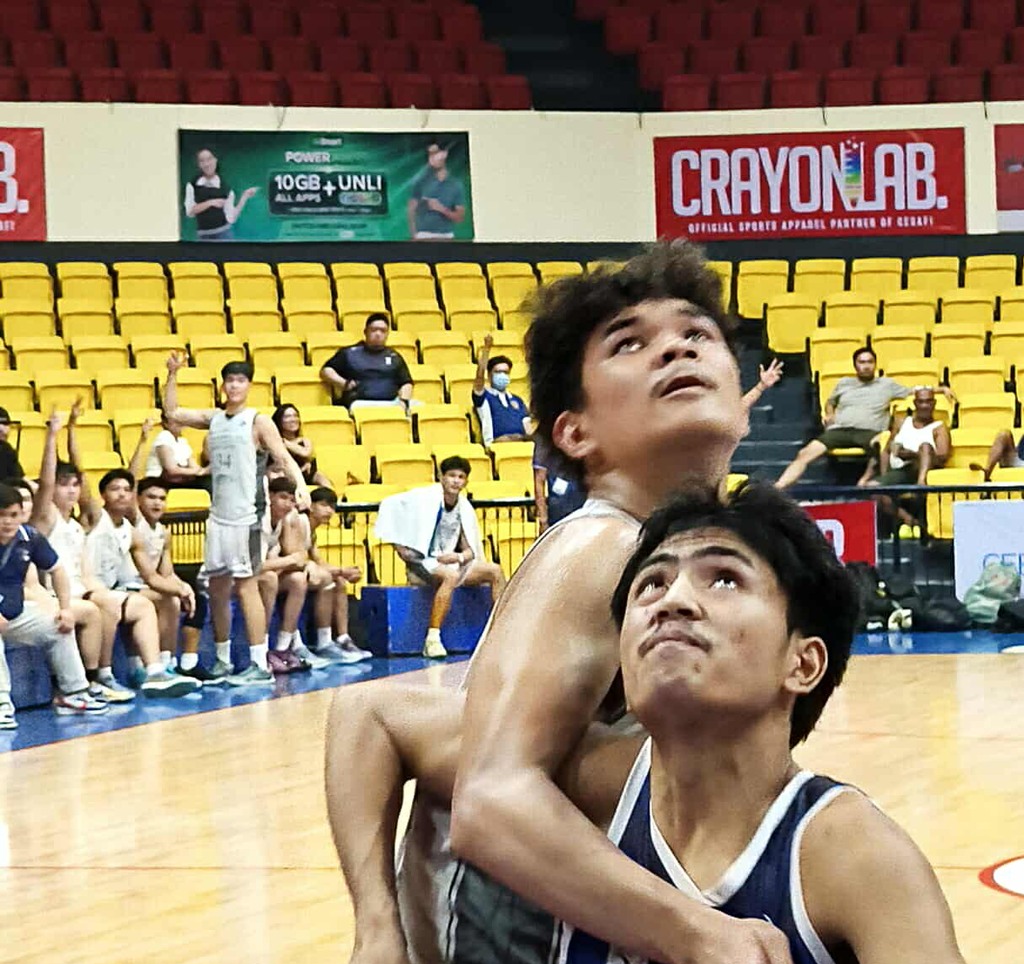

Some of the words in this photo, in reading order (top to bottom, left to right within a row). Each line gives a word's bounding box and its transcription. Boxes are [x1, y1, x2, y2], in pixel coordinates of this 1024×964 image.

[284, 151, 331, 163] POWER
[274, 174, 321, 191] 10GB
[338, 174, 383, 191] UNLI
[274, 193, 294, 203] ALL
[688, 221, 734, 234] OFFICIAL
[739, 219, 777, 232] SPORTS
[830, 217, 876, 230] PARTNER
[880, 216, 892, 228] OF
